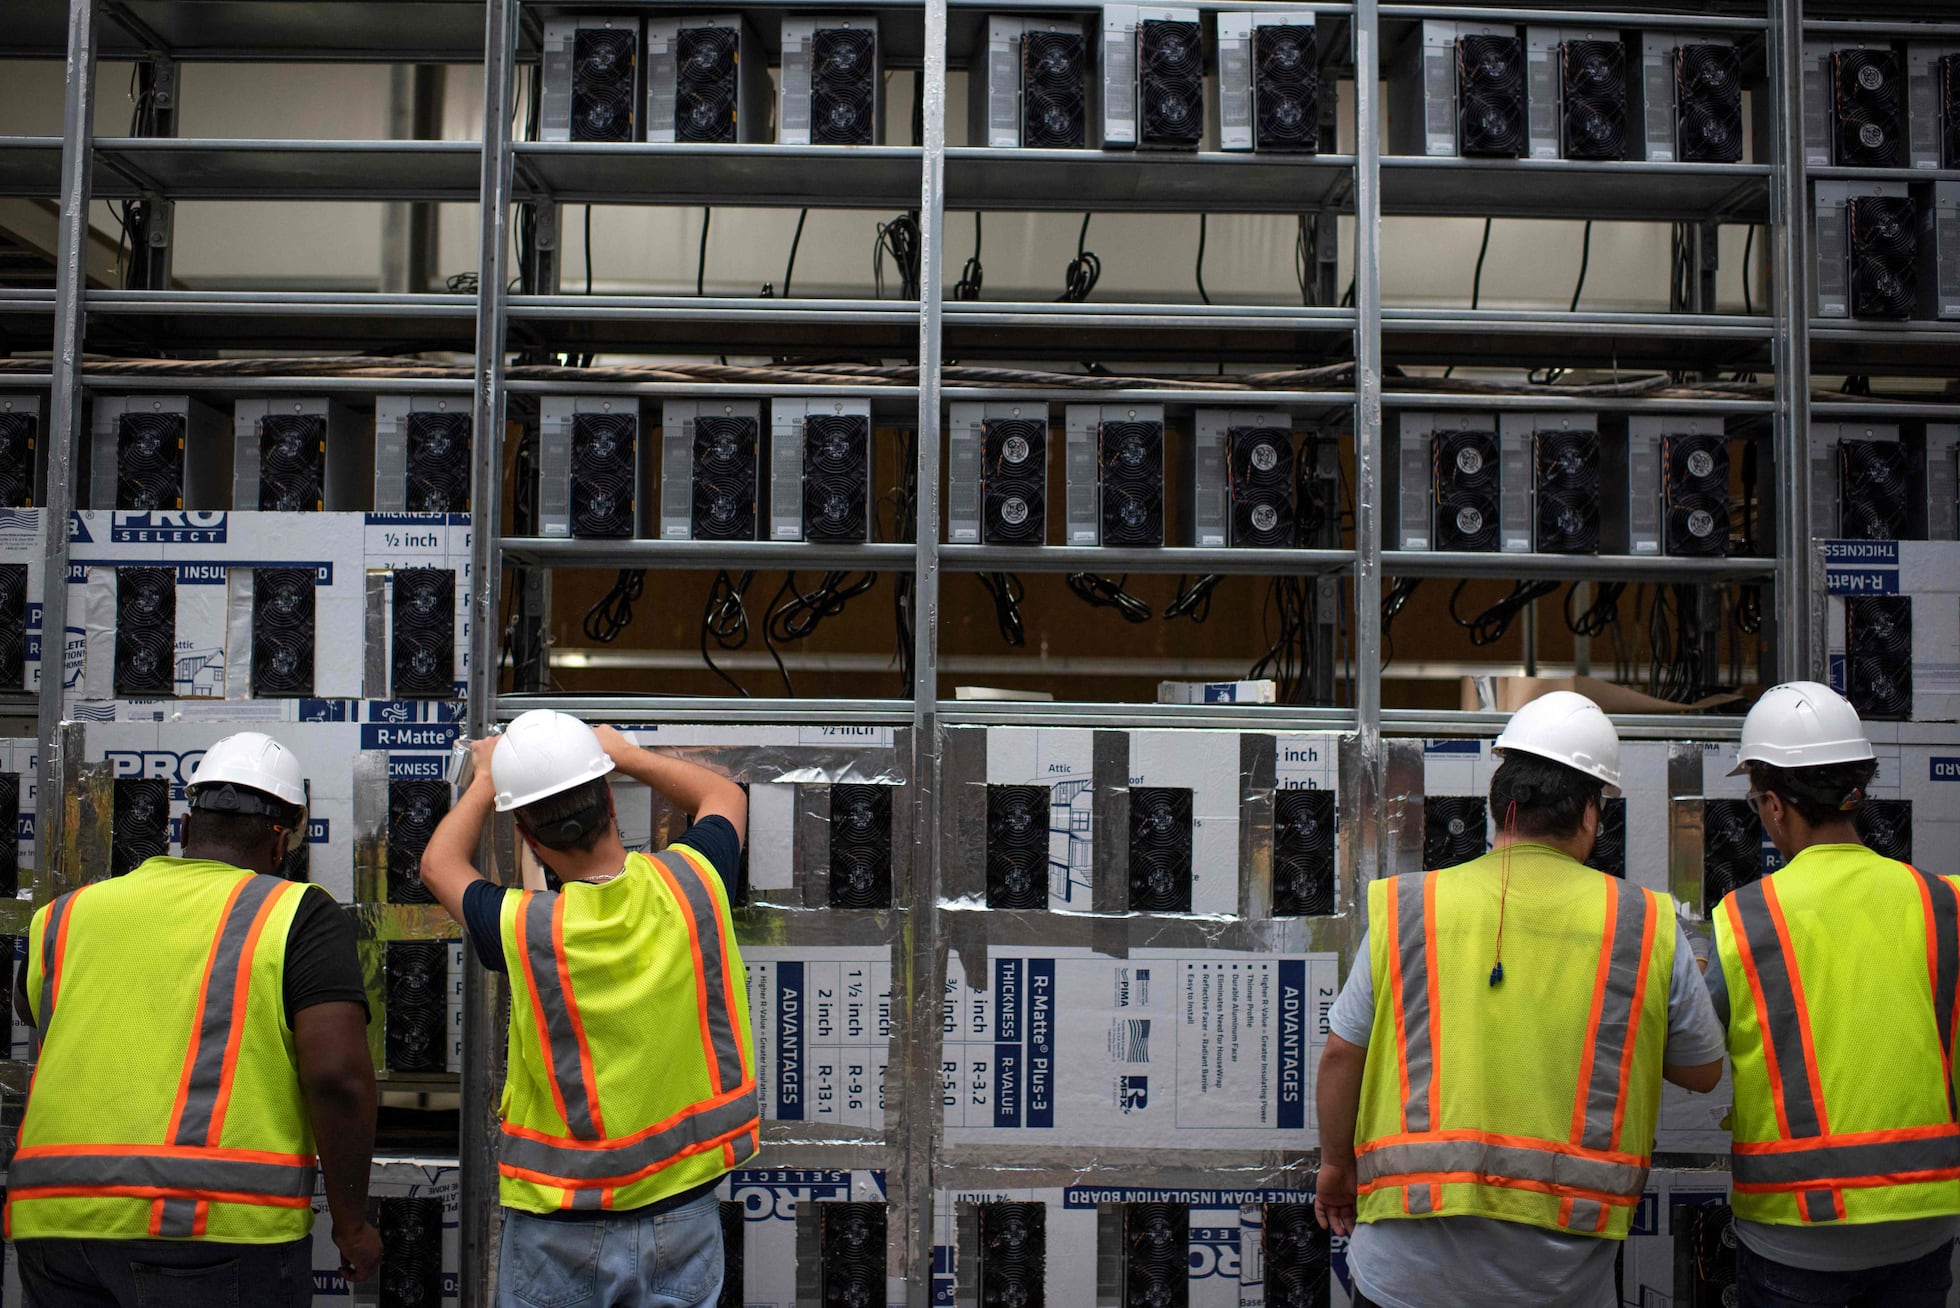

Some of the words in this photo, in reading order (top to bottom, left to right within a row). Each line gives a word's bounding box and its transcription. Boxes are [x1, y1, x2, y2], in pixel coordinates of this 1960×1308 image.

[121, 531, 217, 541] SELECT
[405, 533, 437, 547] inch
[1824, 545, 1895, 557] THICKNESS
[1048, 763, 1071, 773] Attic
[1285, 747, 1317, 762] inch
[759, 975, 767, 999] Higher
[818, 989, 832, 998] 2
[1120, 982, 1129, 1007] PIMA
[1187, 974, 1195, 990] Easy
[1260, 974, 1269, 998] Higher
[1002, 962, 1015, 1038] THICKNESS
[1187, 992, 1194, 1000] to
[818, 1003, 833, 1036] inch
[848, 1003, 863, 1036] inch
[973, 1000, 988, 1033] inch
[1216, 1014, 1224, 1033] Need
[1231, 1003, 1239, 1041] Aluminum
[1261, 999, 1269, 1028] R-Value
[782, 987, 798, 1104] ADVANTAGES
[1201, 1039, 1209, 1067] Radiant
[1260, 1035, 1268, 1062] Greater
[1284, 986, 1299, 1102] ADVANTAGES
[1215, 1046, 1224, 1088] HouseWrap
[759, 1065, 767, 1101] Insulating
[818, 1065, 833, 1113] R-13.1
[848, 1065, 863, 1109] R-9.6
[972, 1062, 987, 1105] R-3.2
[1001, 1057, 1014, 1115] R-VALUE
[1032, 1058, 1048, 1110] Plus-3
[1259, 1063, 1268, 1099] Insulating
[1260, 1101, 1268, 1123] Power
[741, 1171, 841, 1182] SELECT
[1125, 1191, 1217, 1203] INSULATION
[1221, 1191, 1264, 1204] FOAM
